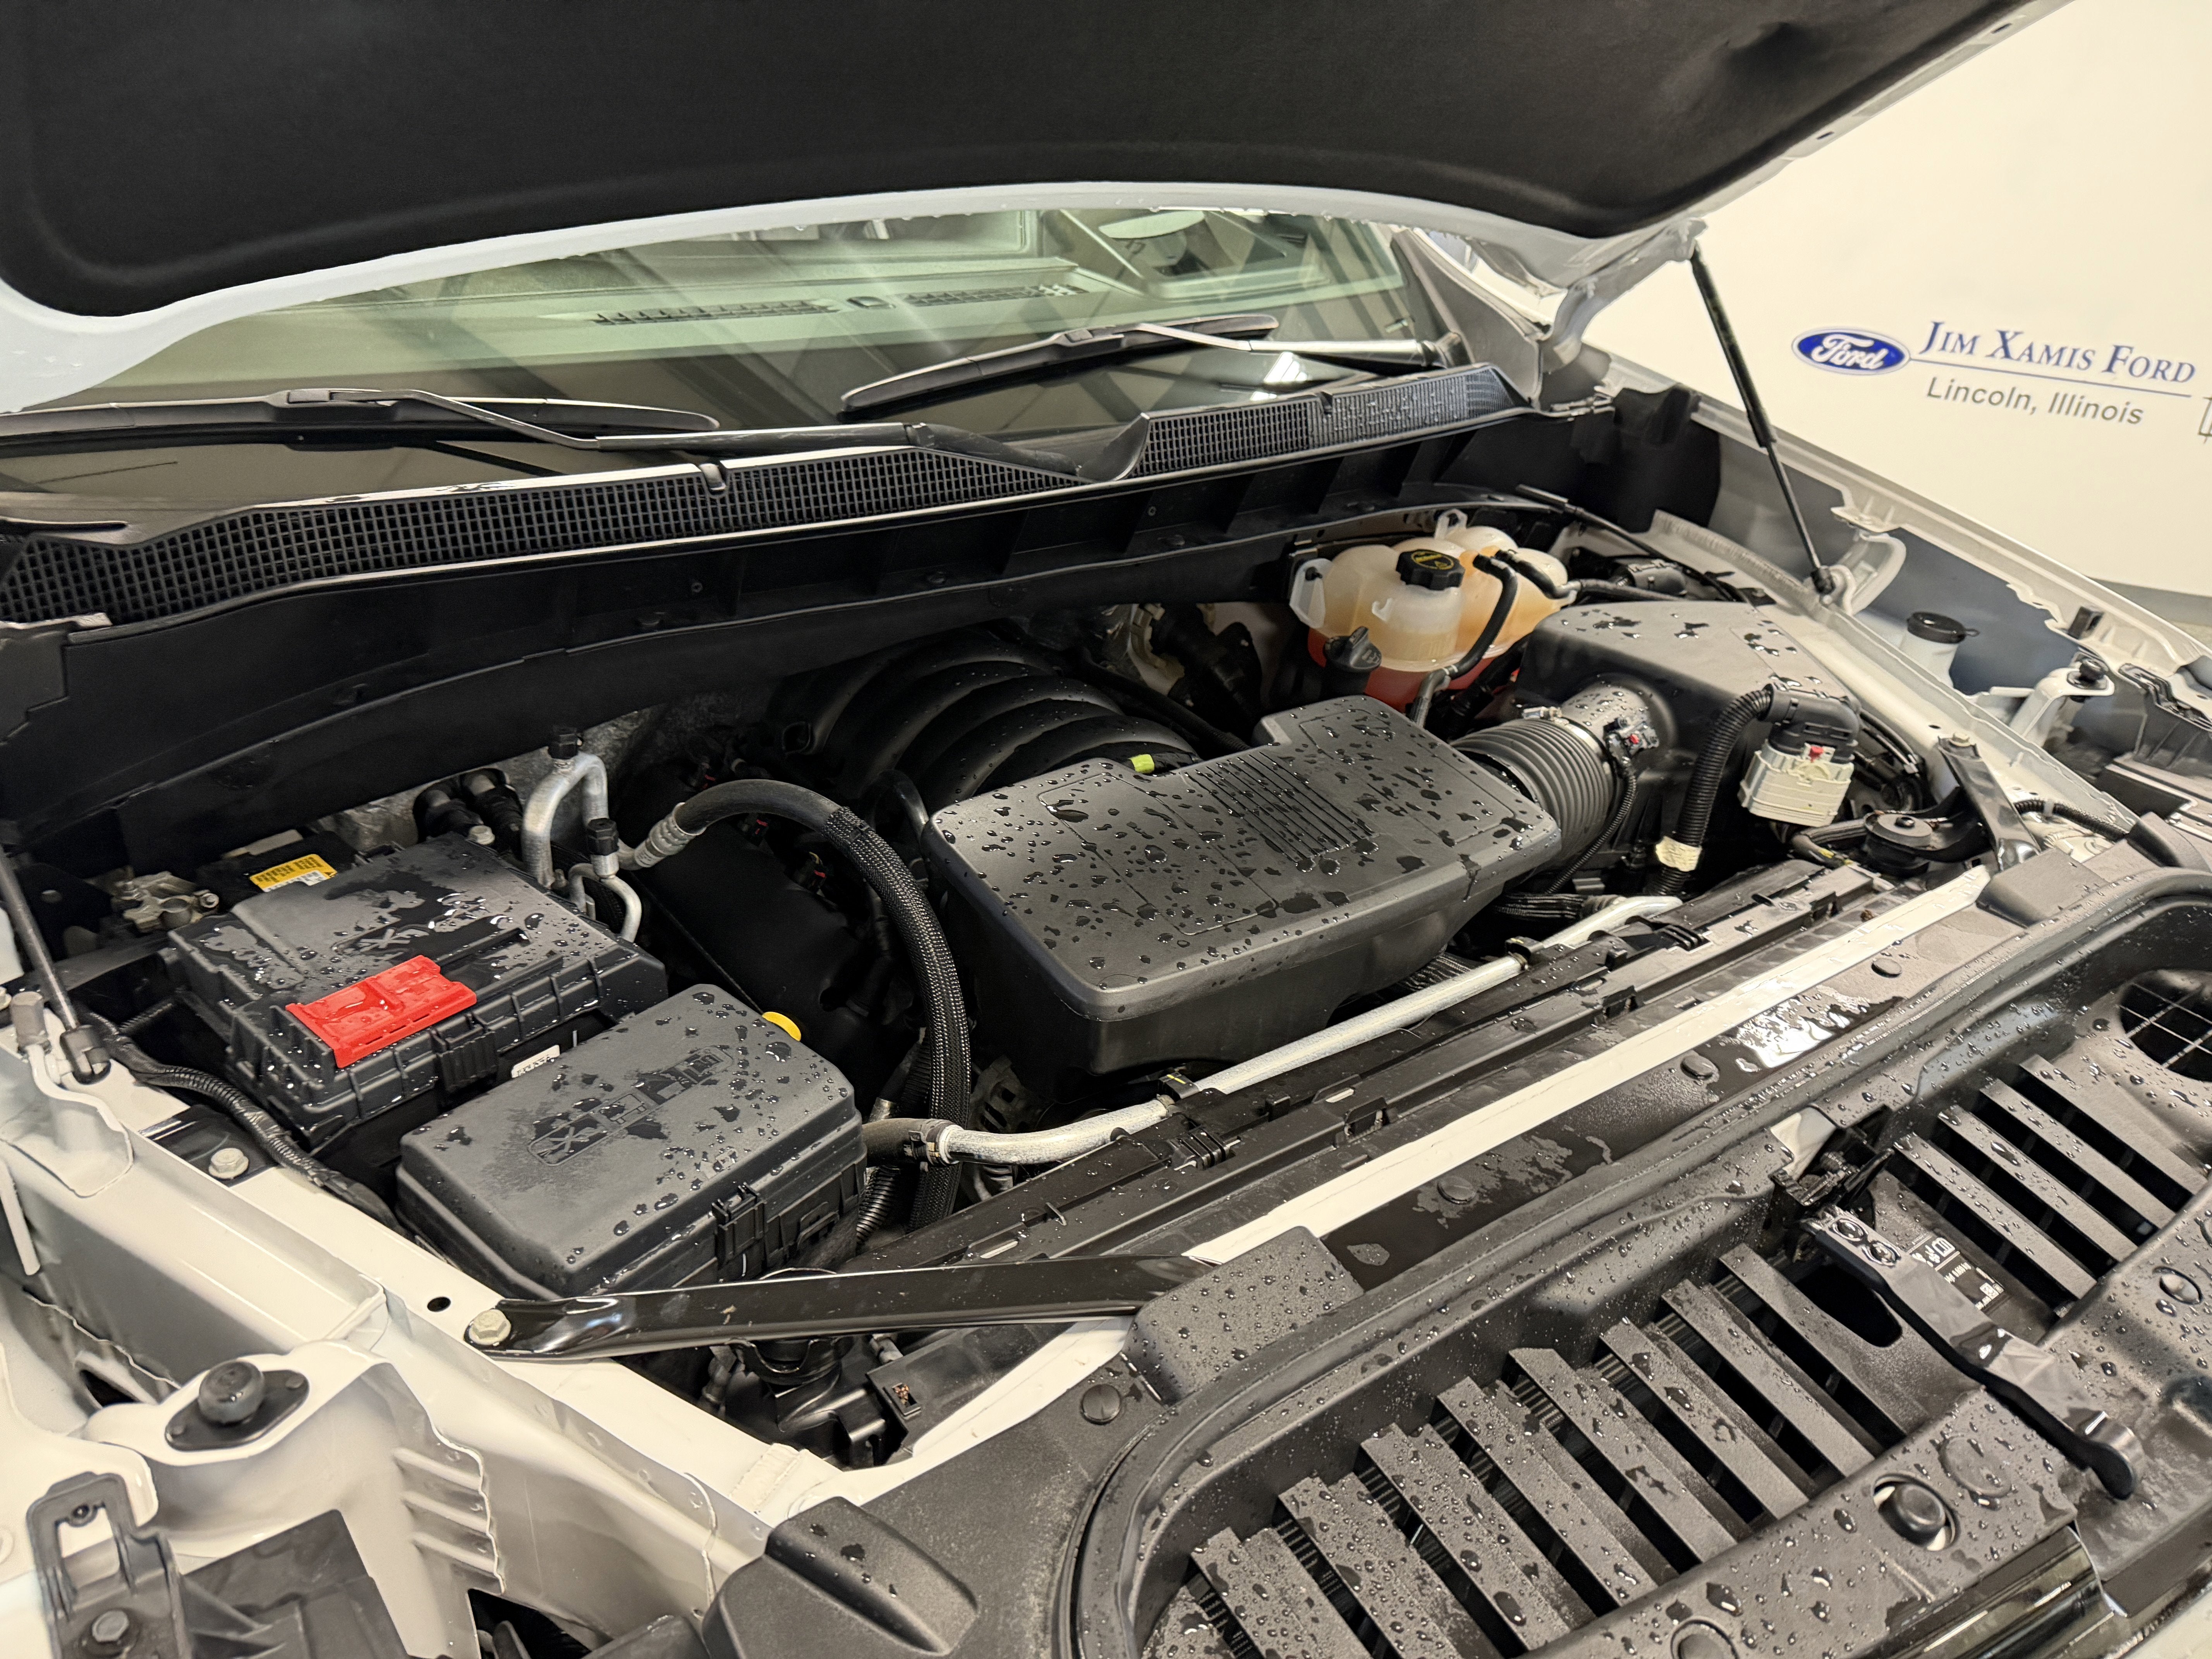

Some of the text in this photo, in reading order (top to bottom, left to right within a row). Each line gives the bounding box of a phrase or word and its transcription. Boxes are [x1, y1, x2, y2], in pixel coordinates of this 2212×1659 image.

[1811, 334, 1889, 369] Ford
[1926, 376, 2144, 424] Lincoln, Illinois
